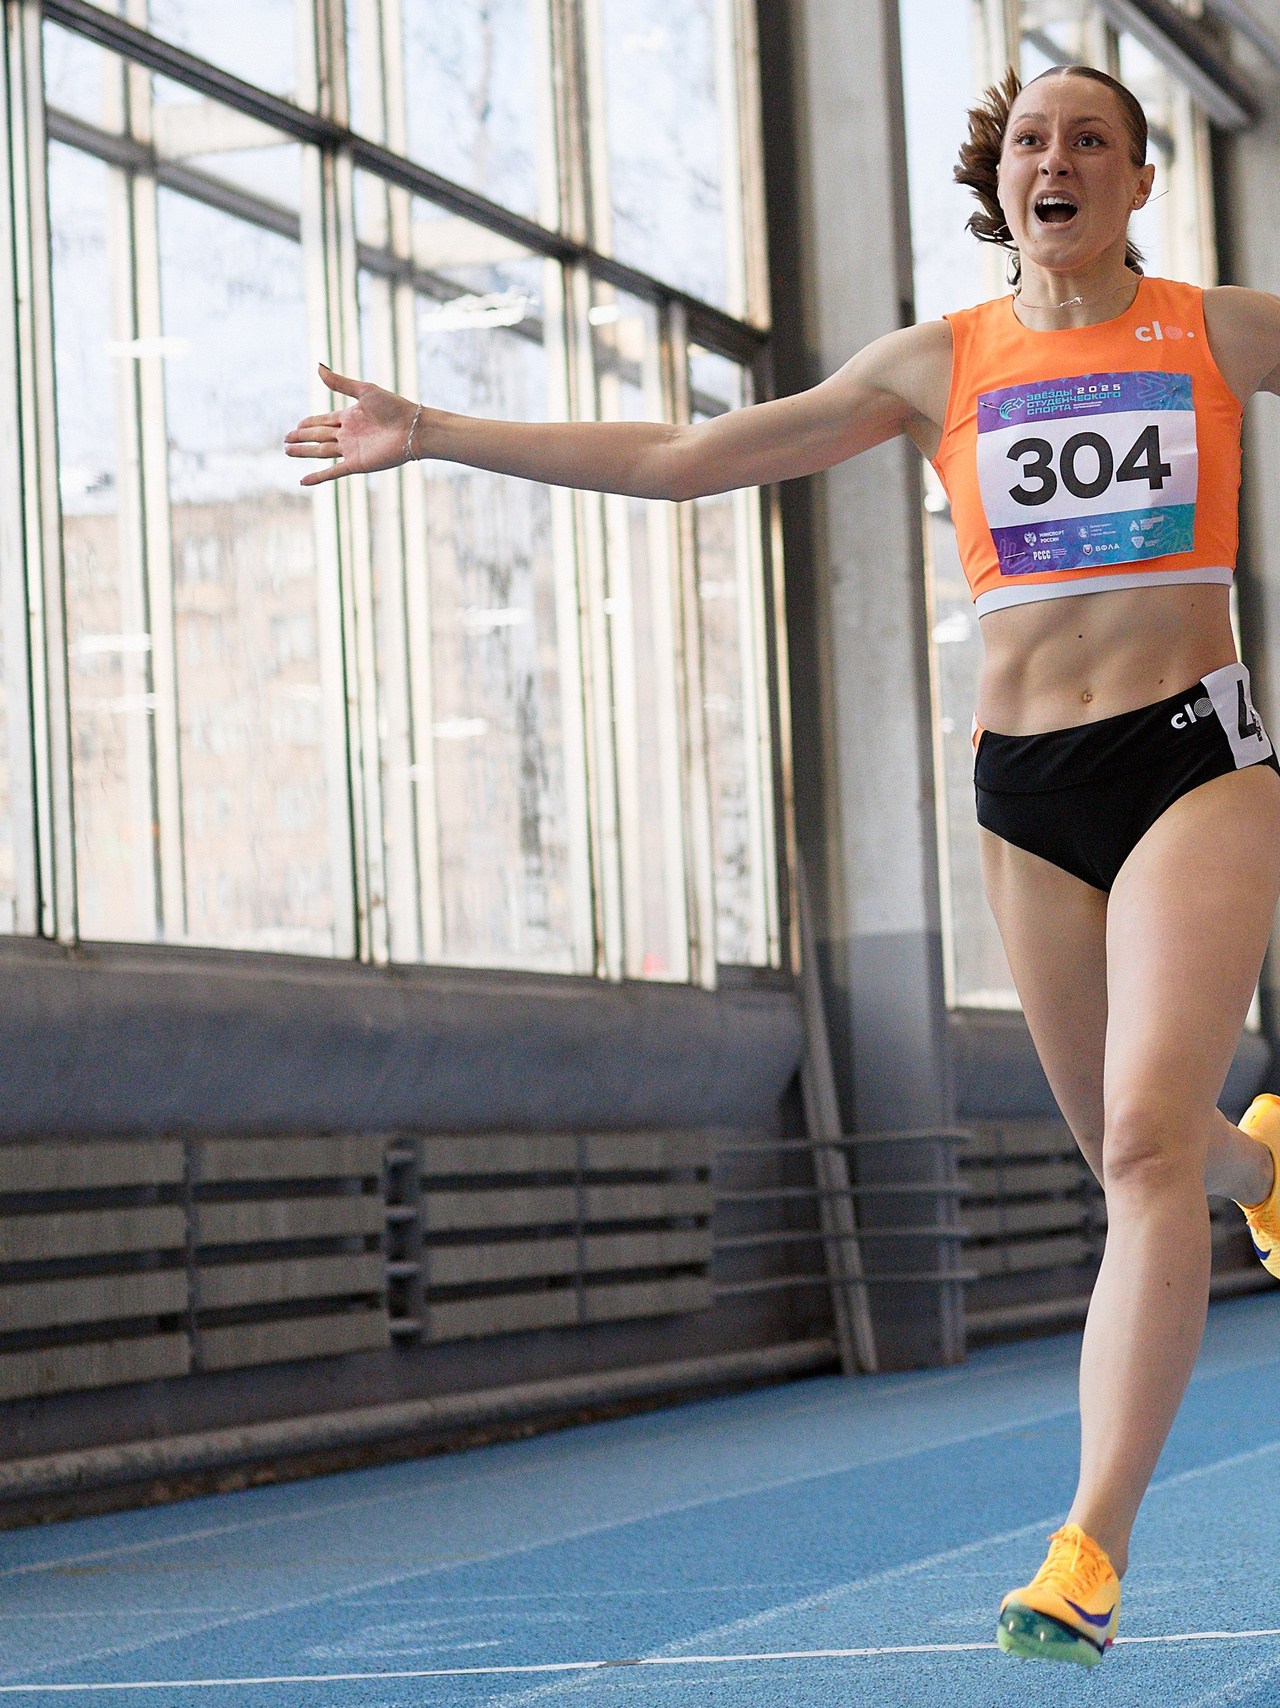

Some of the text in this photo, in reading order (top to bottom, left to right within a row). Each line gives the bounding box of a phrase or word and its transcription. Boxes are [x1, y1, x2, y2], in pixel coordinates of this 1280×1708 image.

[1027, 384, 1120, 401] ЗВЁЗДЫ 2025
[1027, 391, 1120, 408] СТУДЕНЧЕСКОГО
[1027, 403, 1071, 415] СПОРТА
[1006, 425, 1171, 506] 304
